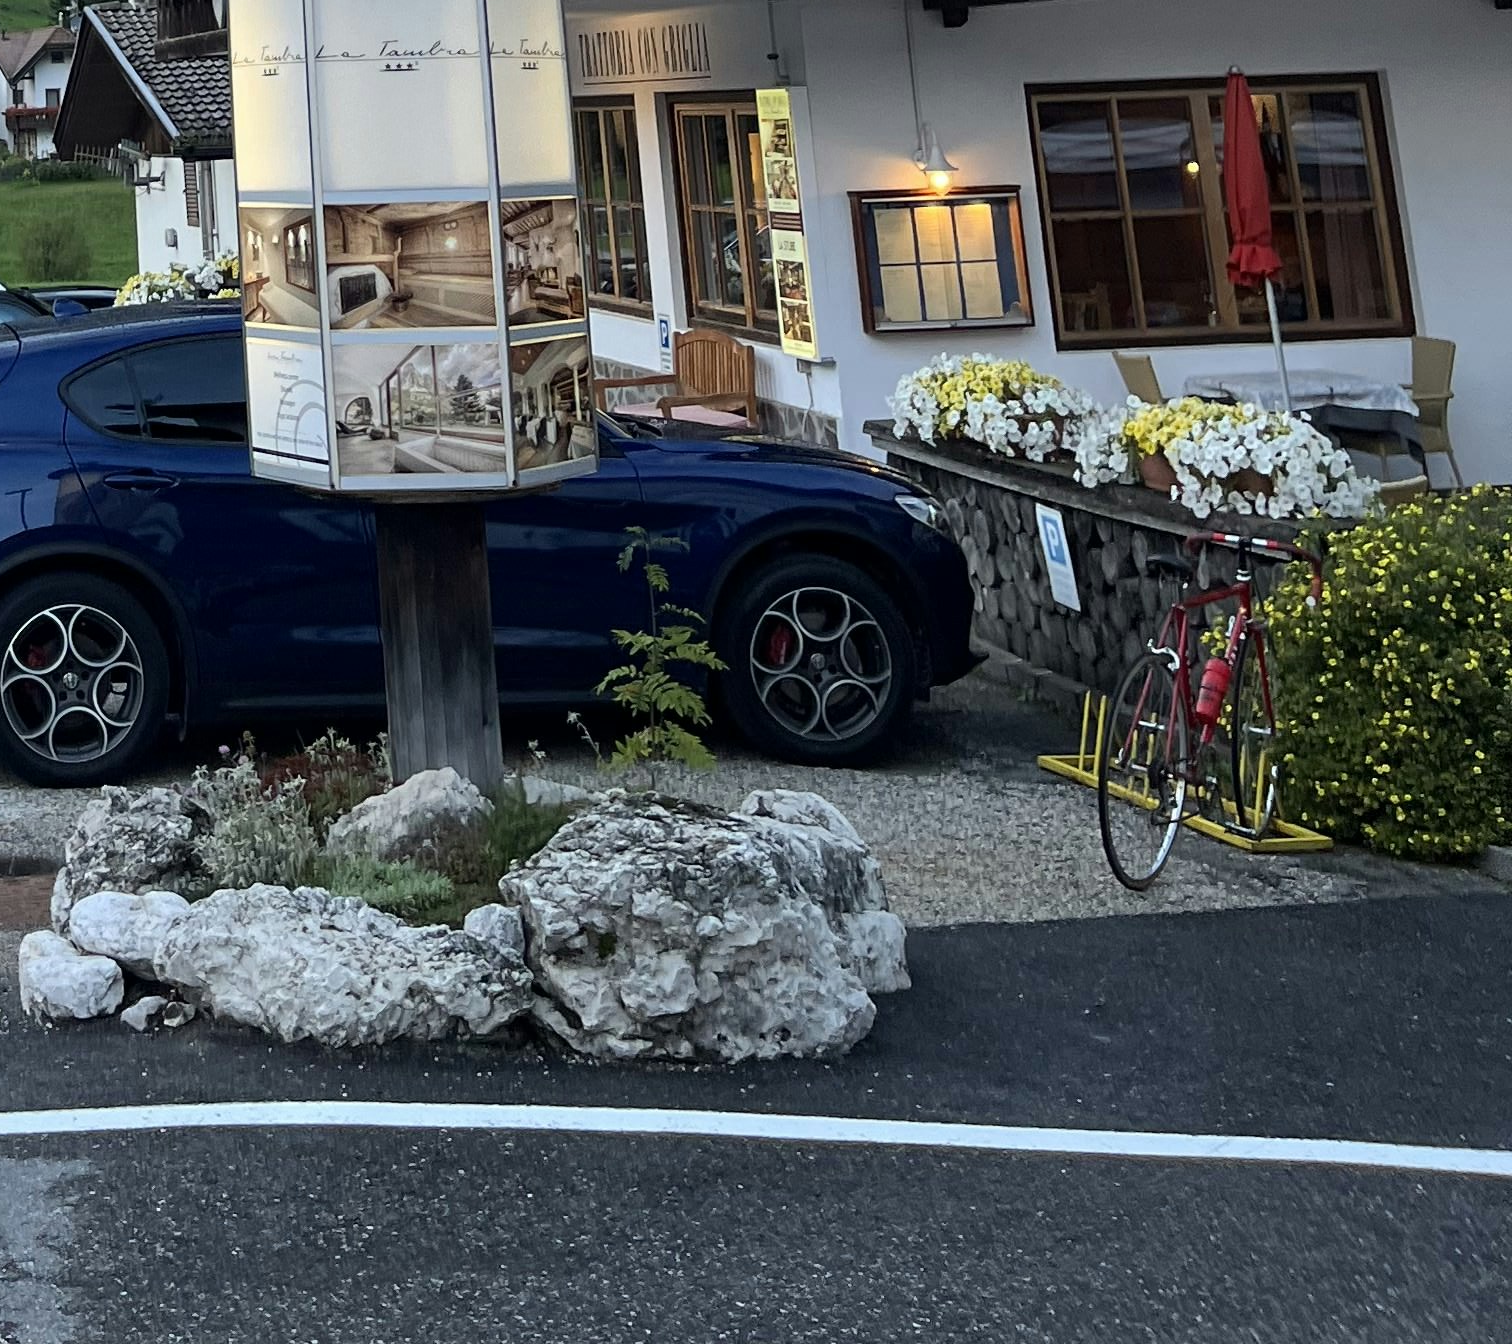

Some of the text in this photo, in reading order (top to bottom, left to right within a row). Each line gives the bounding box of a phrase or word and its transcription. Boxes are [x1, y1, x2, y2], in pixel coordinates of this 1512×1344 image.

[261, 45, 306, 62] Tambra
[314, 39, 480, 59] La Tambra
[519, 38, 565, 56] Tambra
[578, 21, 710, 77] TRATTORIA CON GRIGLIA
[1044, 520, 1059, 558] P
